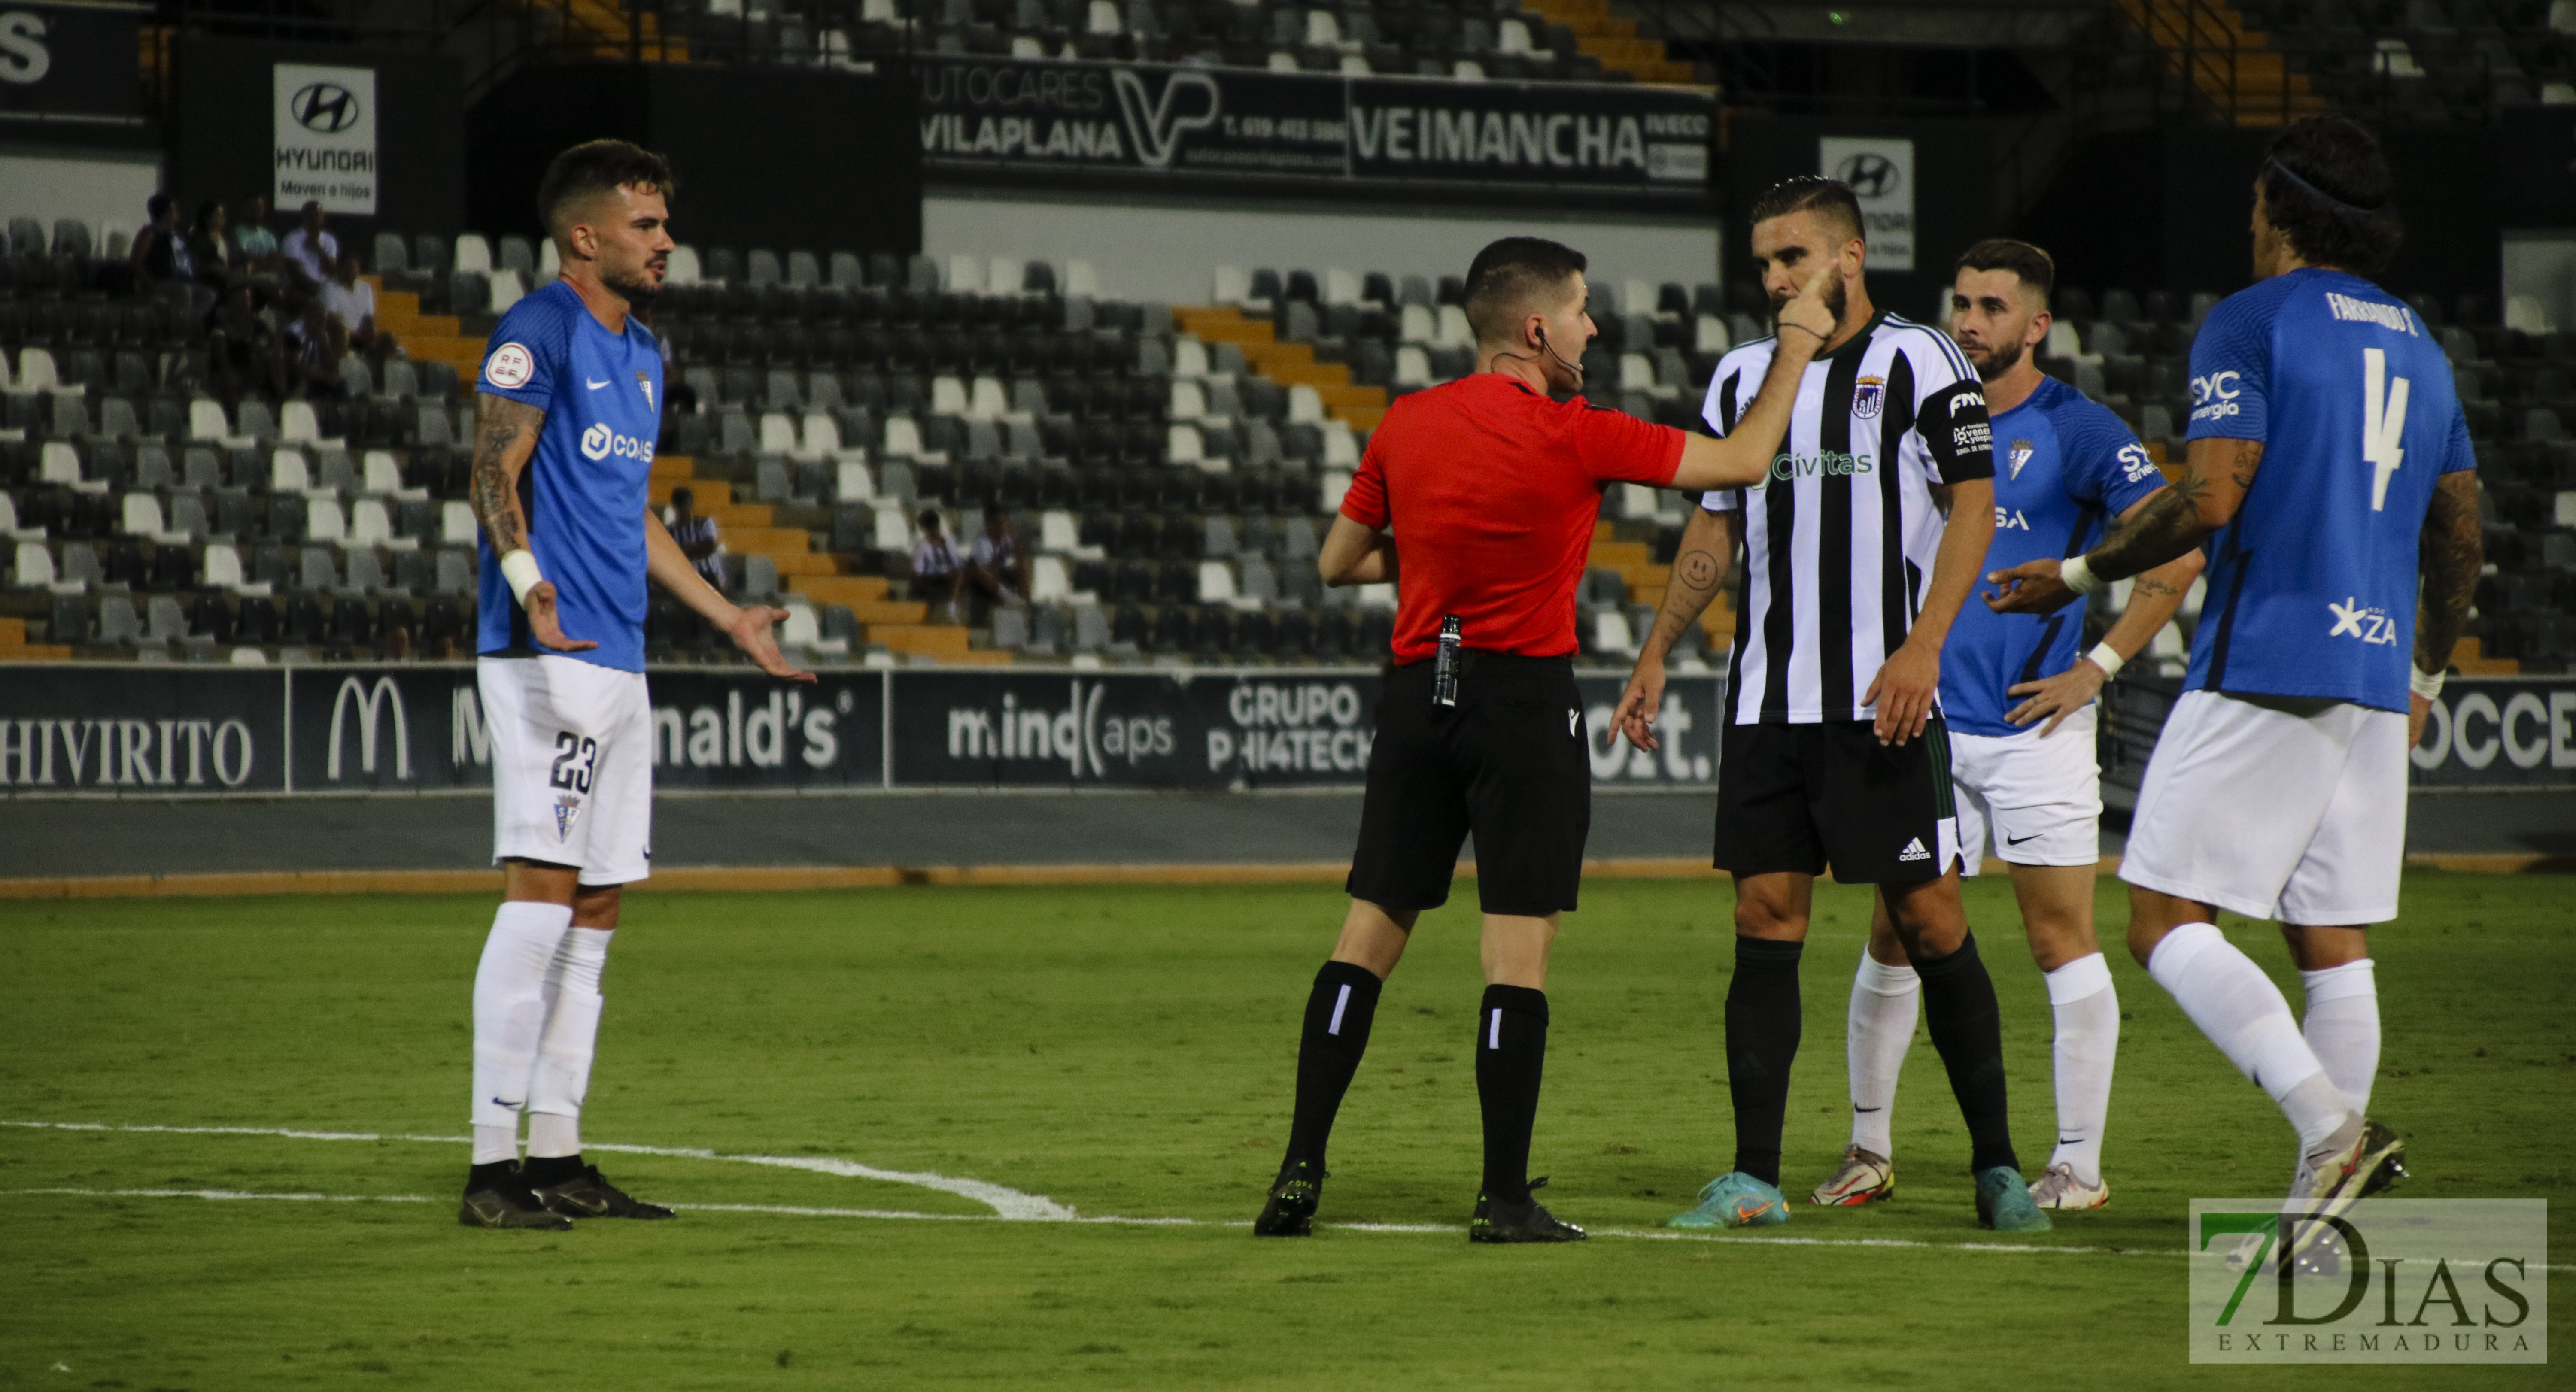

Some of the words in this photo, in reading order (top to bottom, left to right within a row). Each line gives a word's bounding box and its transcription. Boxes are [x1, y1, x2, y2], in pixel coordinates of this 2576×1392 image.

[919, 65, 1103, 109] UTOCARES
[920, 112, 1122, 159] VILAPLANA
[1351, 106, 1645, 167] VEIMANCHA
[276, 147, 374, 173] HYUNDAI
[2192, 370, 2241, 402] SYC
[2363, 348, 2410, 511] 4
[1229, 683, 1361, 726] GRUPO
[452, 687, 840, 768] Mnald's
[549, 731, 596, 794] 23
[1899, 852, 1931, 861] adidas
